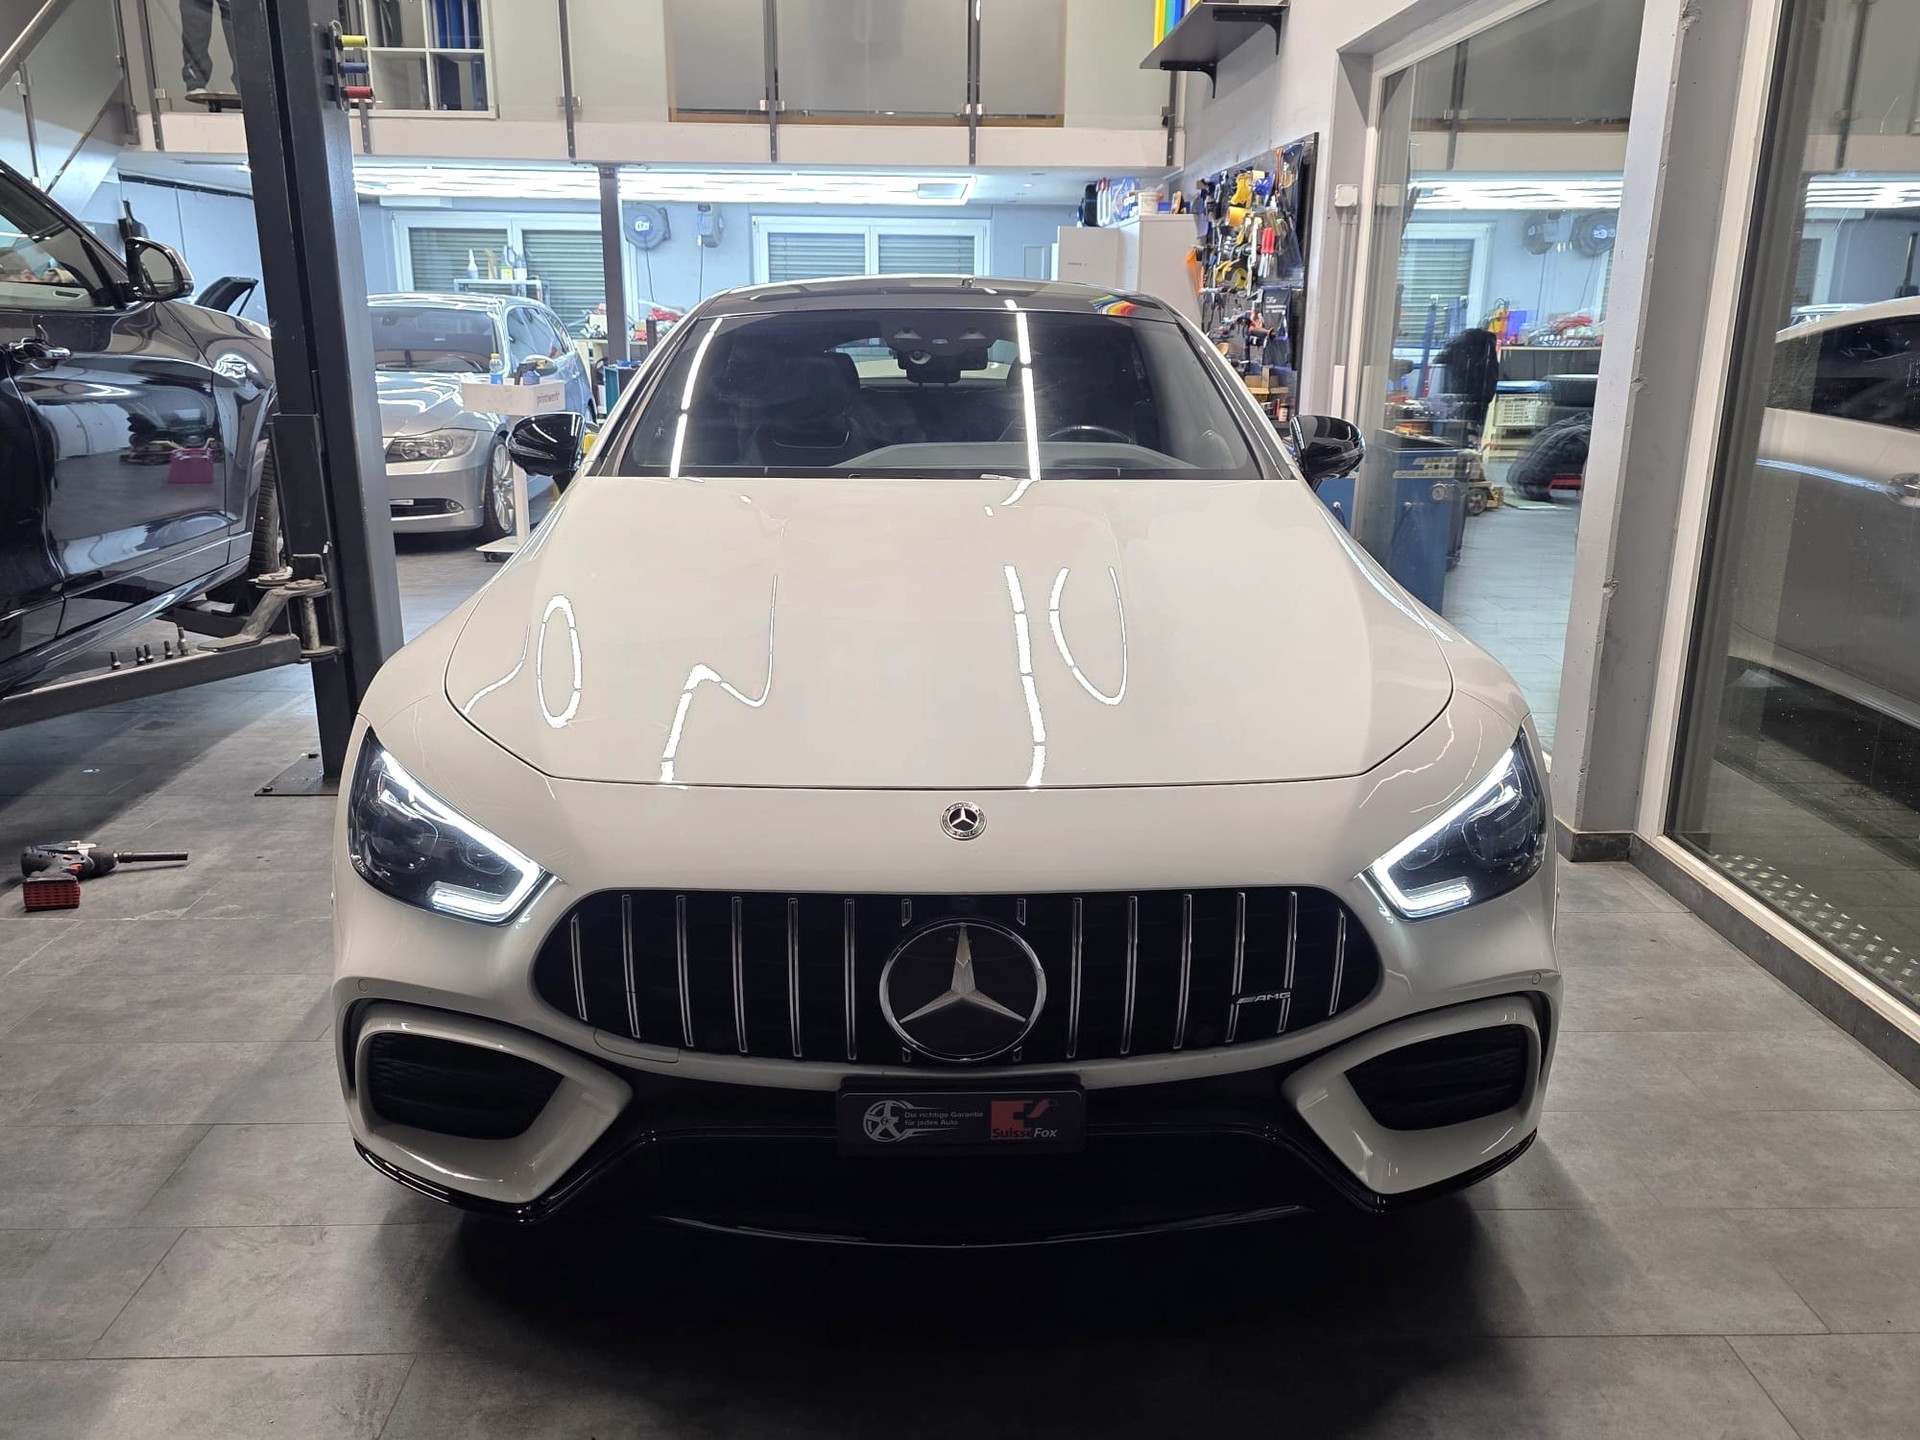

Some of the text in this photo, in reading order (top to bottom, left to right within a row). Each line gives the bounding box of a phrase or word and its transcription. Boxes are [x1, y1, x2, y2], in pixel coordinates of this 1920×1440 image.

[1254, 991, 1291, 1002] AMG
[919, 1111, 949, 1120] richtige
[950, 1110, 984, 1118] Garantie
[904, 1118, 915, 1126] für
[917, 1119, 938, 1127] jeden
